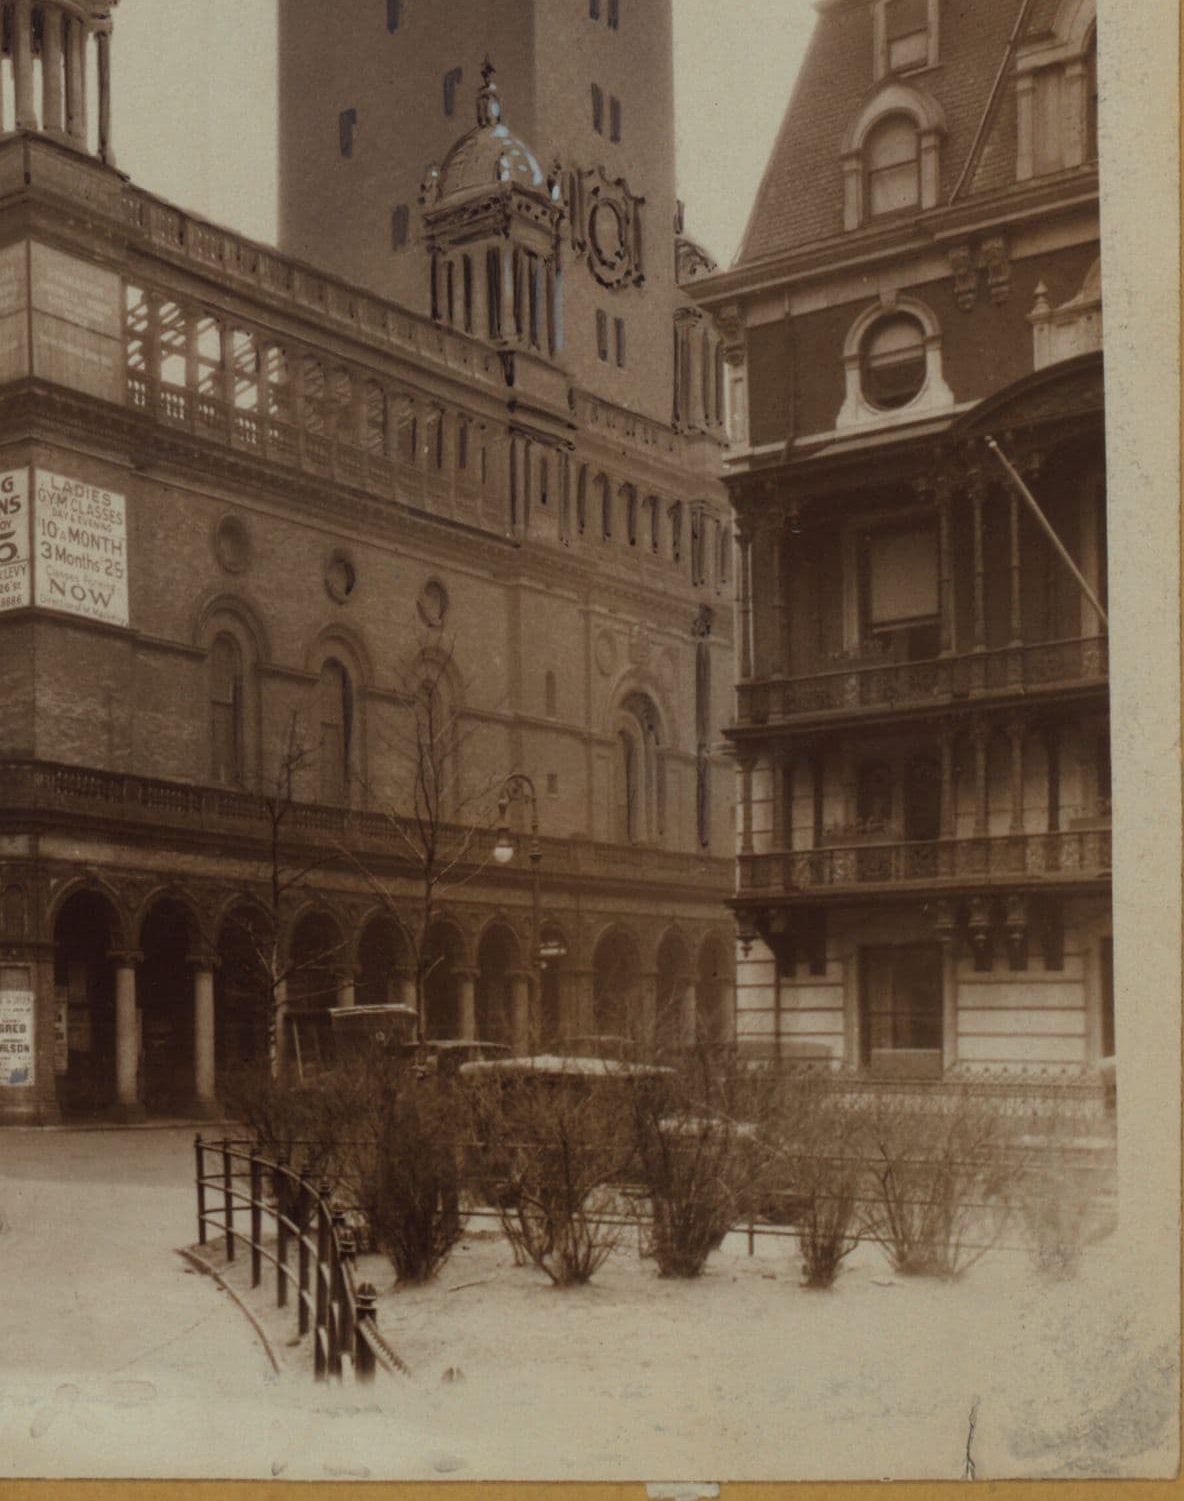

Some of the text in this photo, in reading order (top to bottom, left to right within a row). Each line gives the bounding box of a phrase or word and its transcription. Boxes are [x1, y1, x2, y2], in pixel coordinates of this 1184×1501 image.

[38, 487, 123, 525] GYM CLASSES
[51, 475, 112, 507] LADIES
[52, 506, 69, 520] DAY
[40, 540, 52, 560] 3
[55, 544, 101, 572] Months
[68, 526, 123, 557] MONTH
[49, 578, 113, 610] NOW
